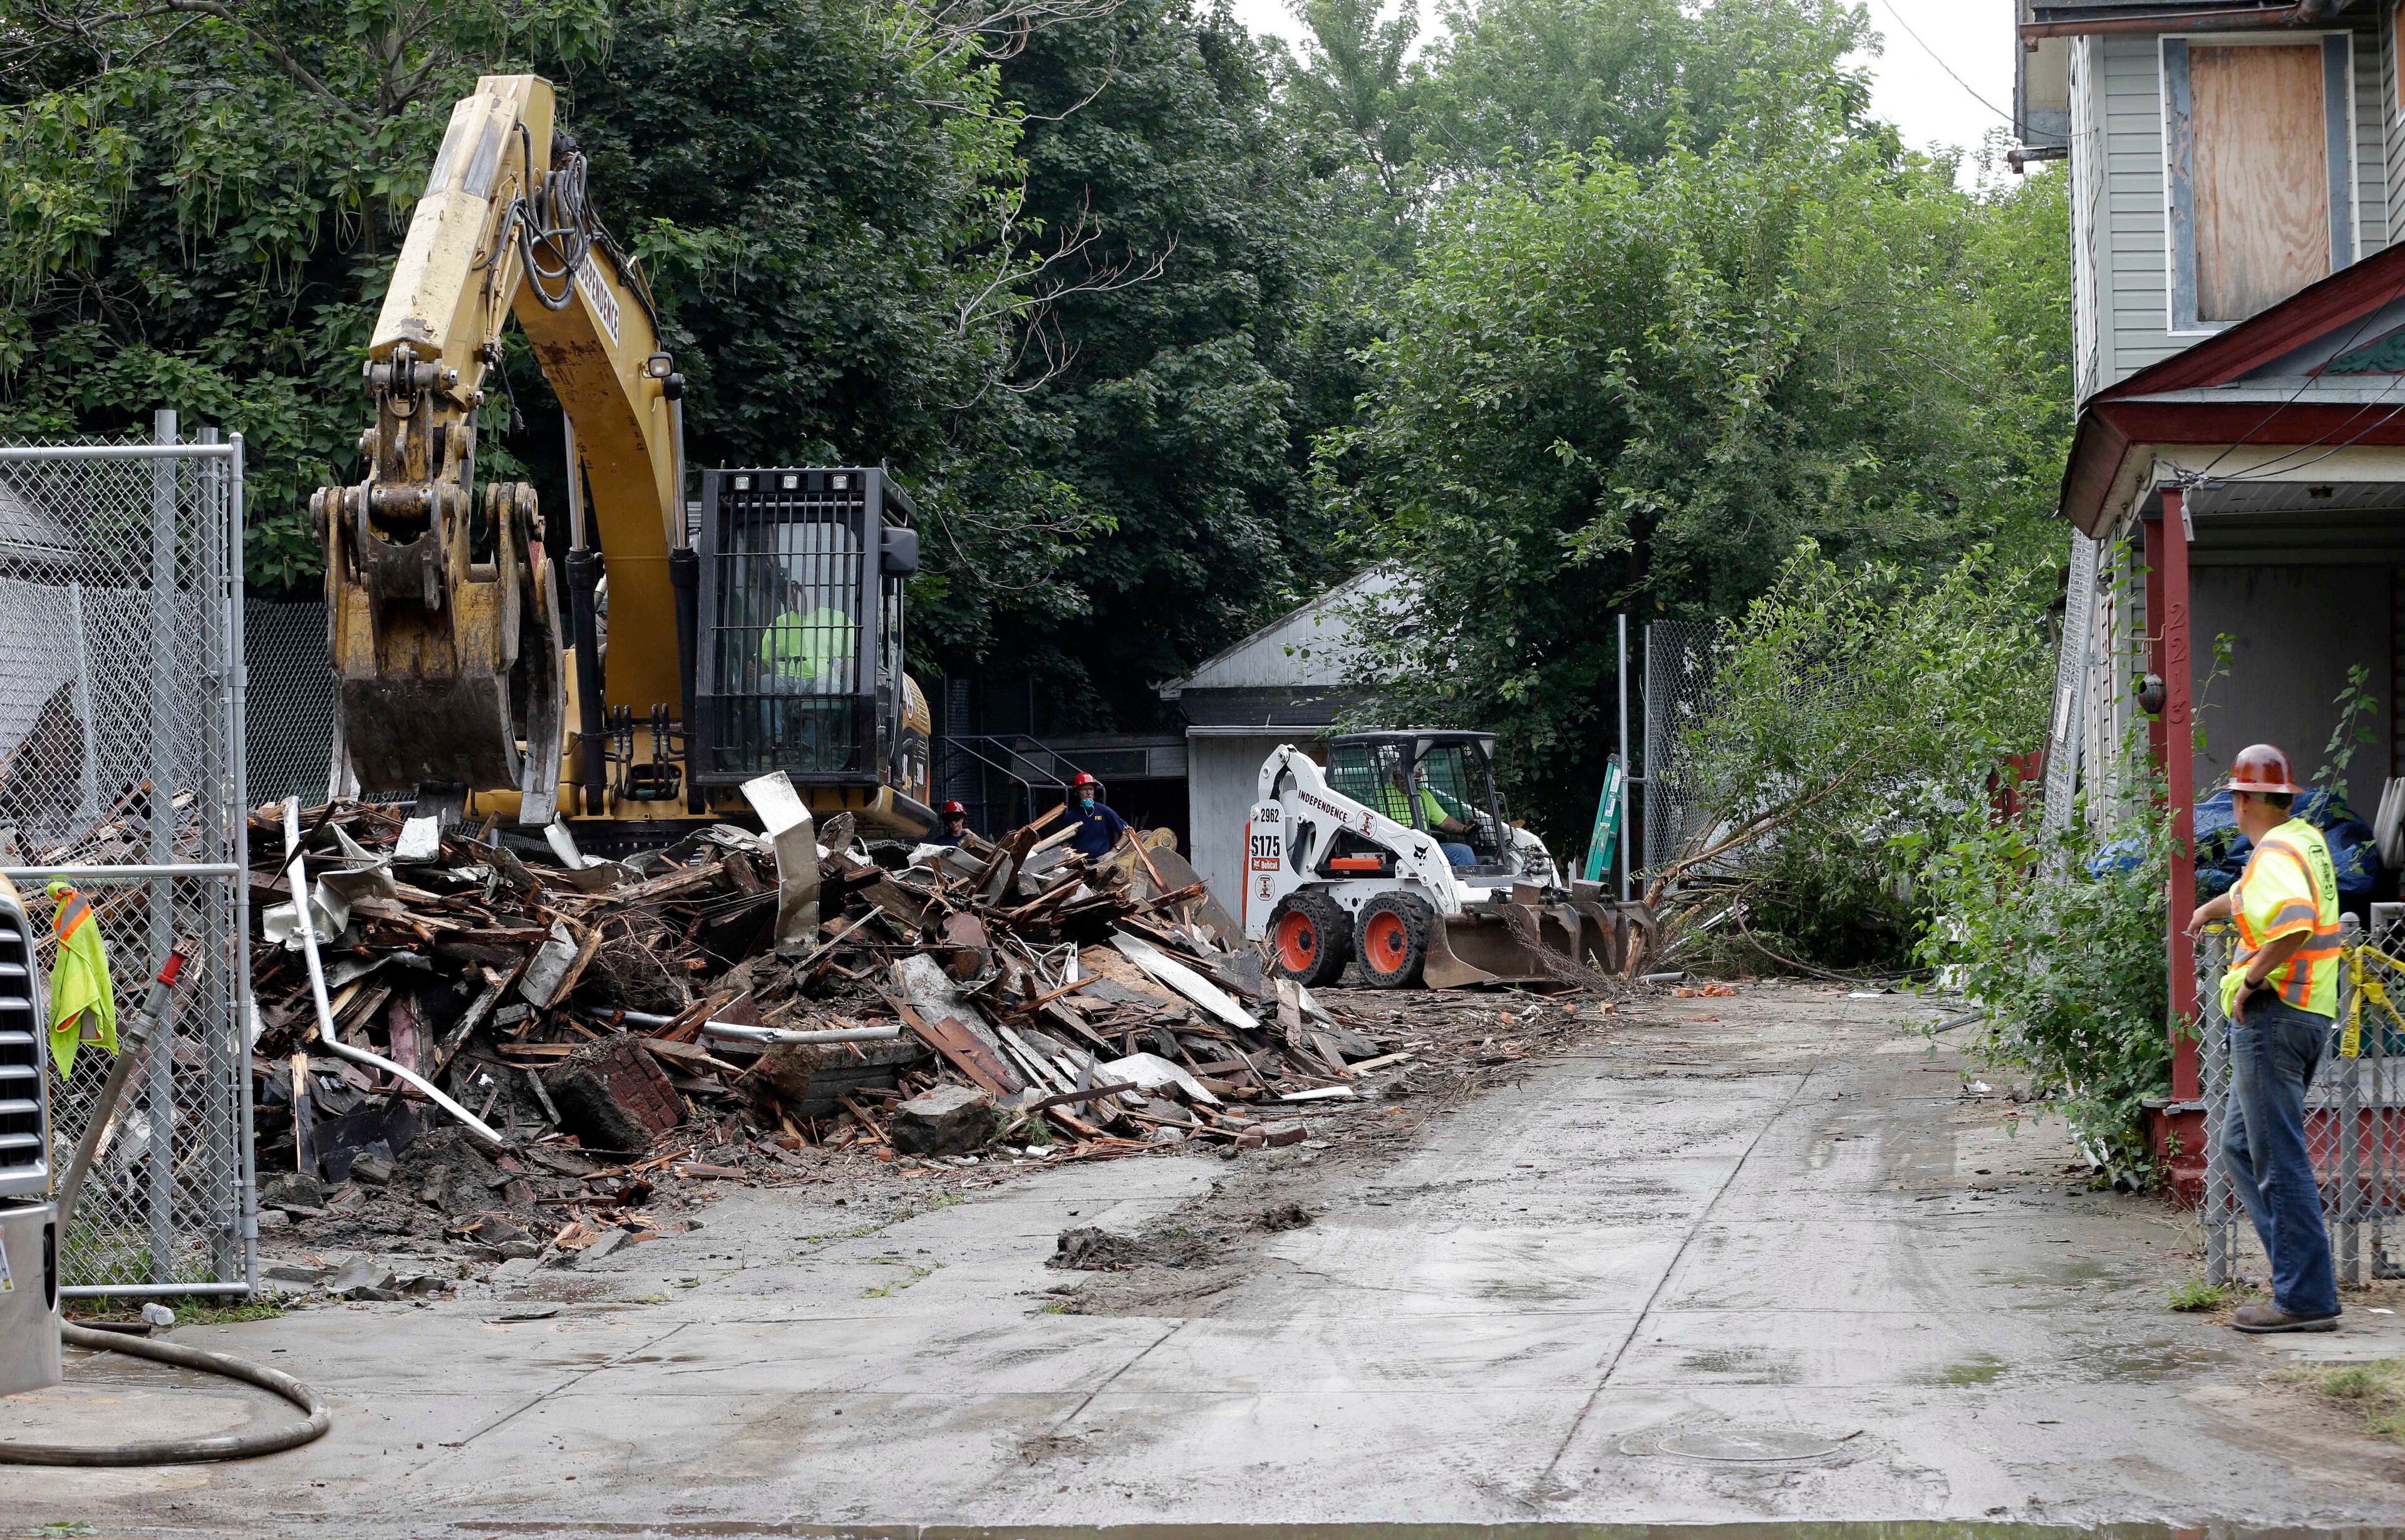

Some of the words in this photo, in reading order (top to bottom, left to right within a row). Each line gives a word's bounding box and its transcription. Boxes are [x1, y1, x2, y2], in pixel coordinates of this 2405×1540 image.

[578, 257, 618, 340] DEPENDENCE
[1298, 789, 1348, 823] INDEPENDENCE
[1261, 808, 1279, 822] 2962
[1251, 835, 1280, 856] S175
[1261, 860, 1278, 869] Bobcat
[2342, 1035, 2356, 1049] NOT
